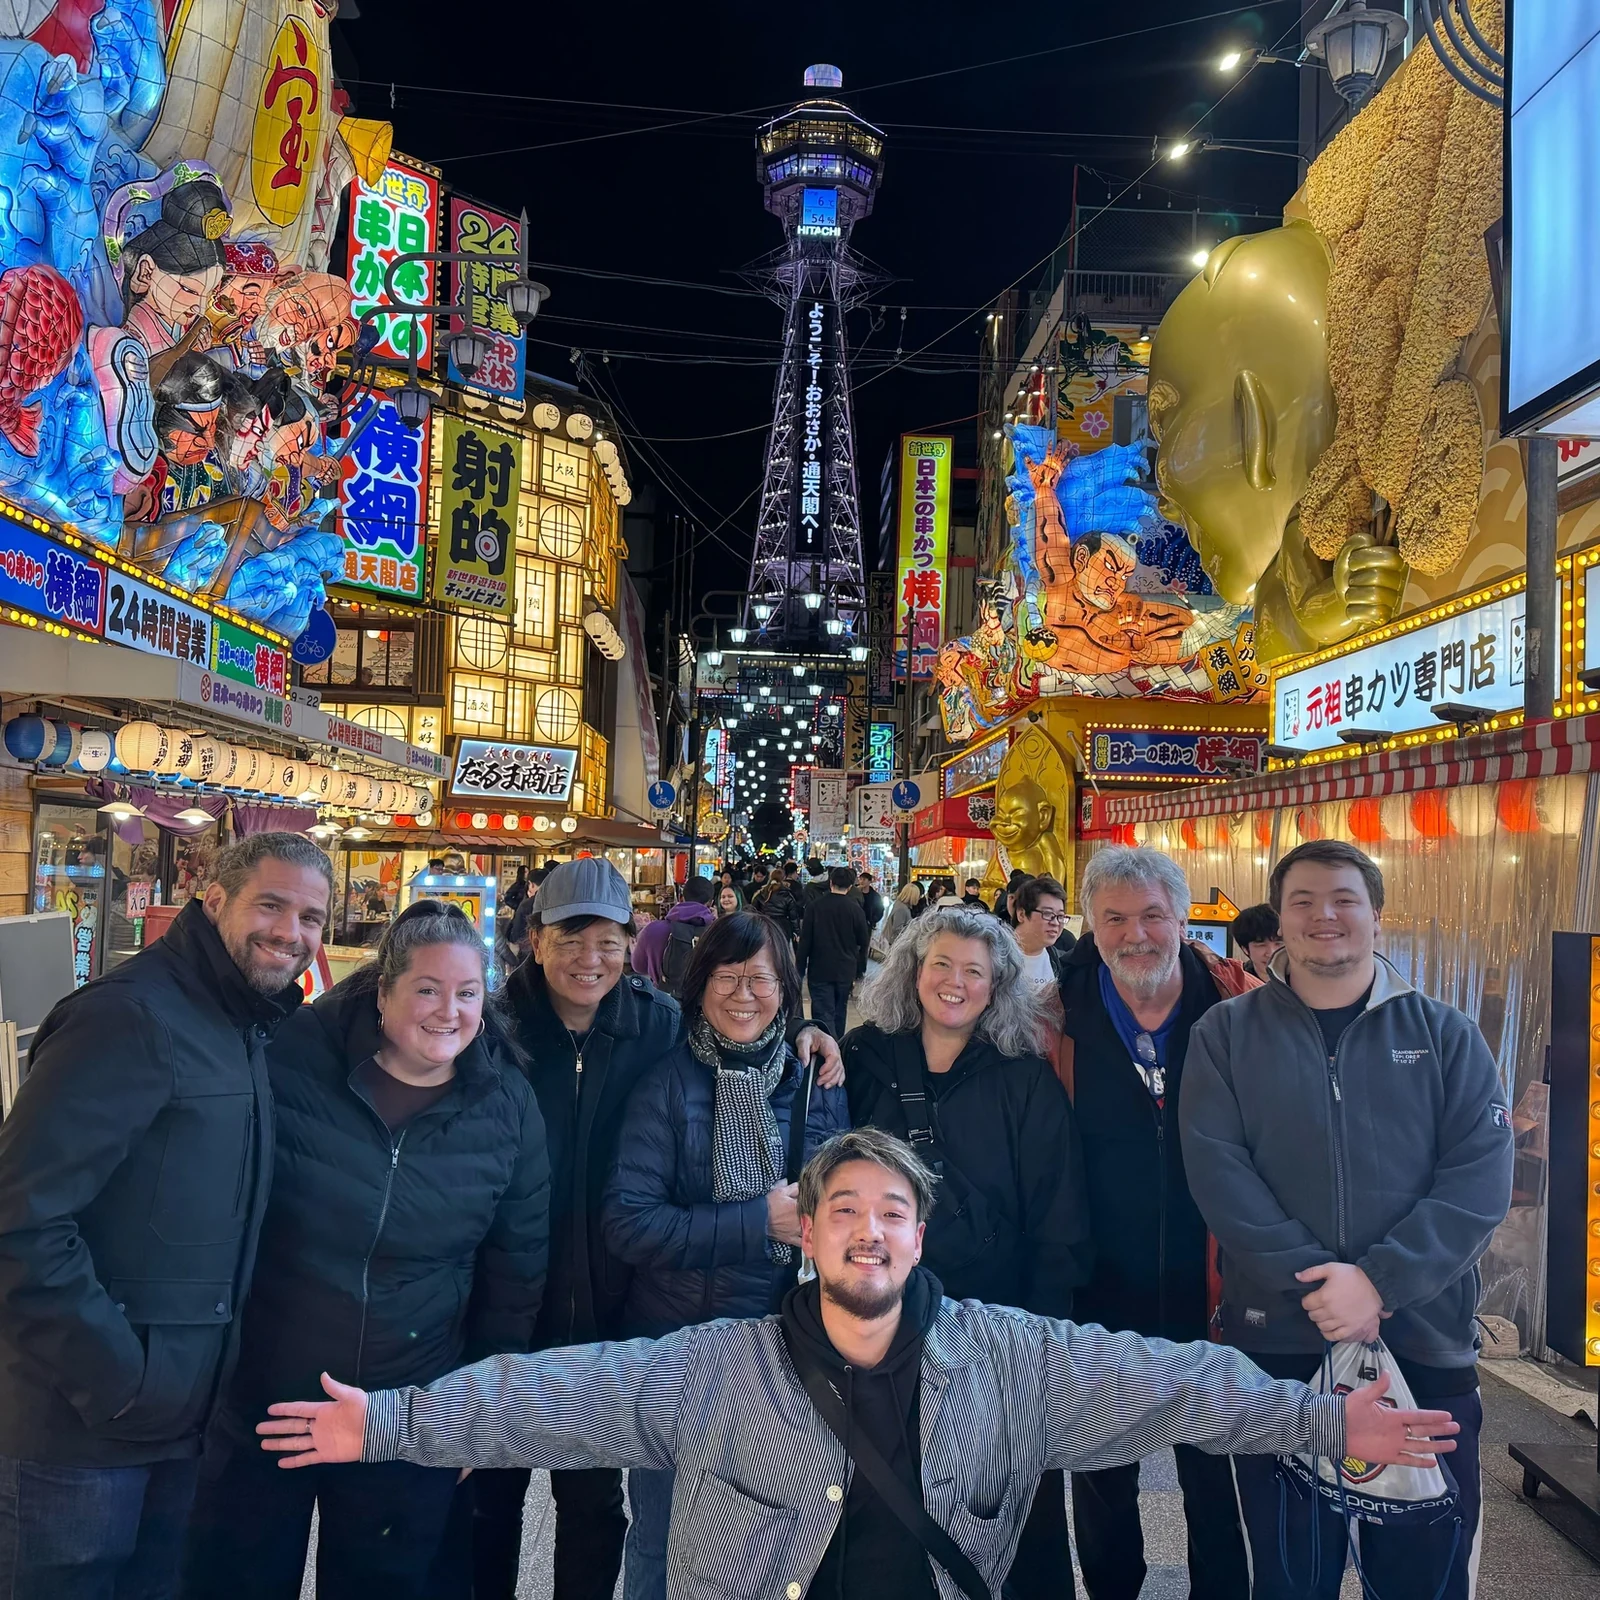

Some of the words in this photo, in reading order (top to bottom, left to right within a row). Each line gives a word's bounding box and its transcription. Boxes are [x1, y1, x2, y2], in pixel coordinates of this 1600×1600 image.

[797, 225, 841, 237] HITACHI
[555, 463, 576, 478] 大阪
[908, 442, 945, 457] 新世界
[449, 430, 516, 576] 射的
[913, 459, 936, 568] 日本一の串かつ
[45, 550, 101, 627] 横綱
[344, 551, 418, 593] 通天閣店
[444, 582, 506, 608] チャンピオン
[902, 569, 942, 651] 横綱
[108, 584, 208, 665] 24時間営業
[255, 643, 285, 695] 横綱
[1209, 646, 1241, 697] 横綱
[213, 682, 262, 715] 日本一の串かつ
[457, 757, 570, 795] だるま商店
[1110, 742, 1193, 764] 日本一の串かつ
[1195, 737, 1260, 773] 横綱
